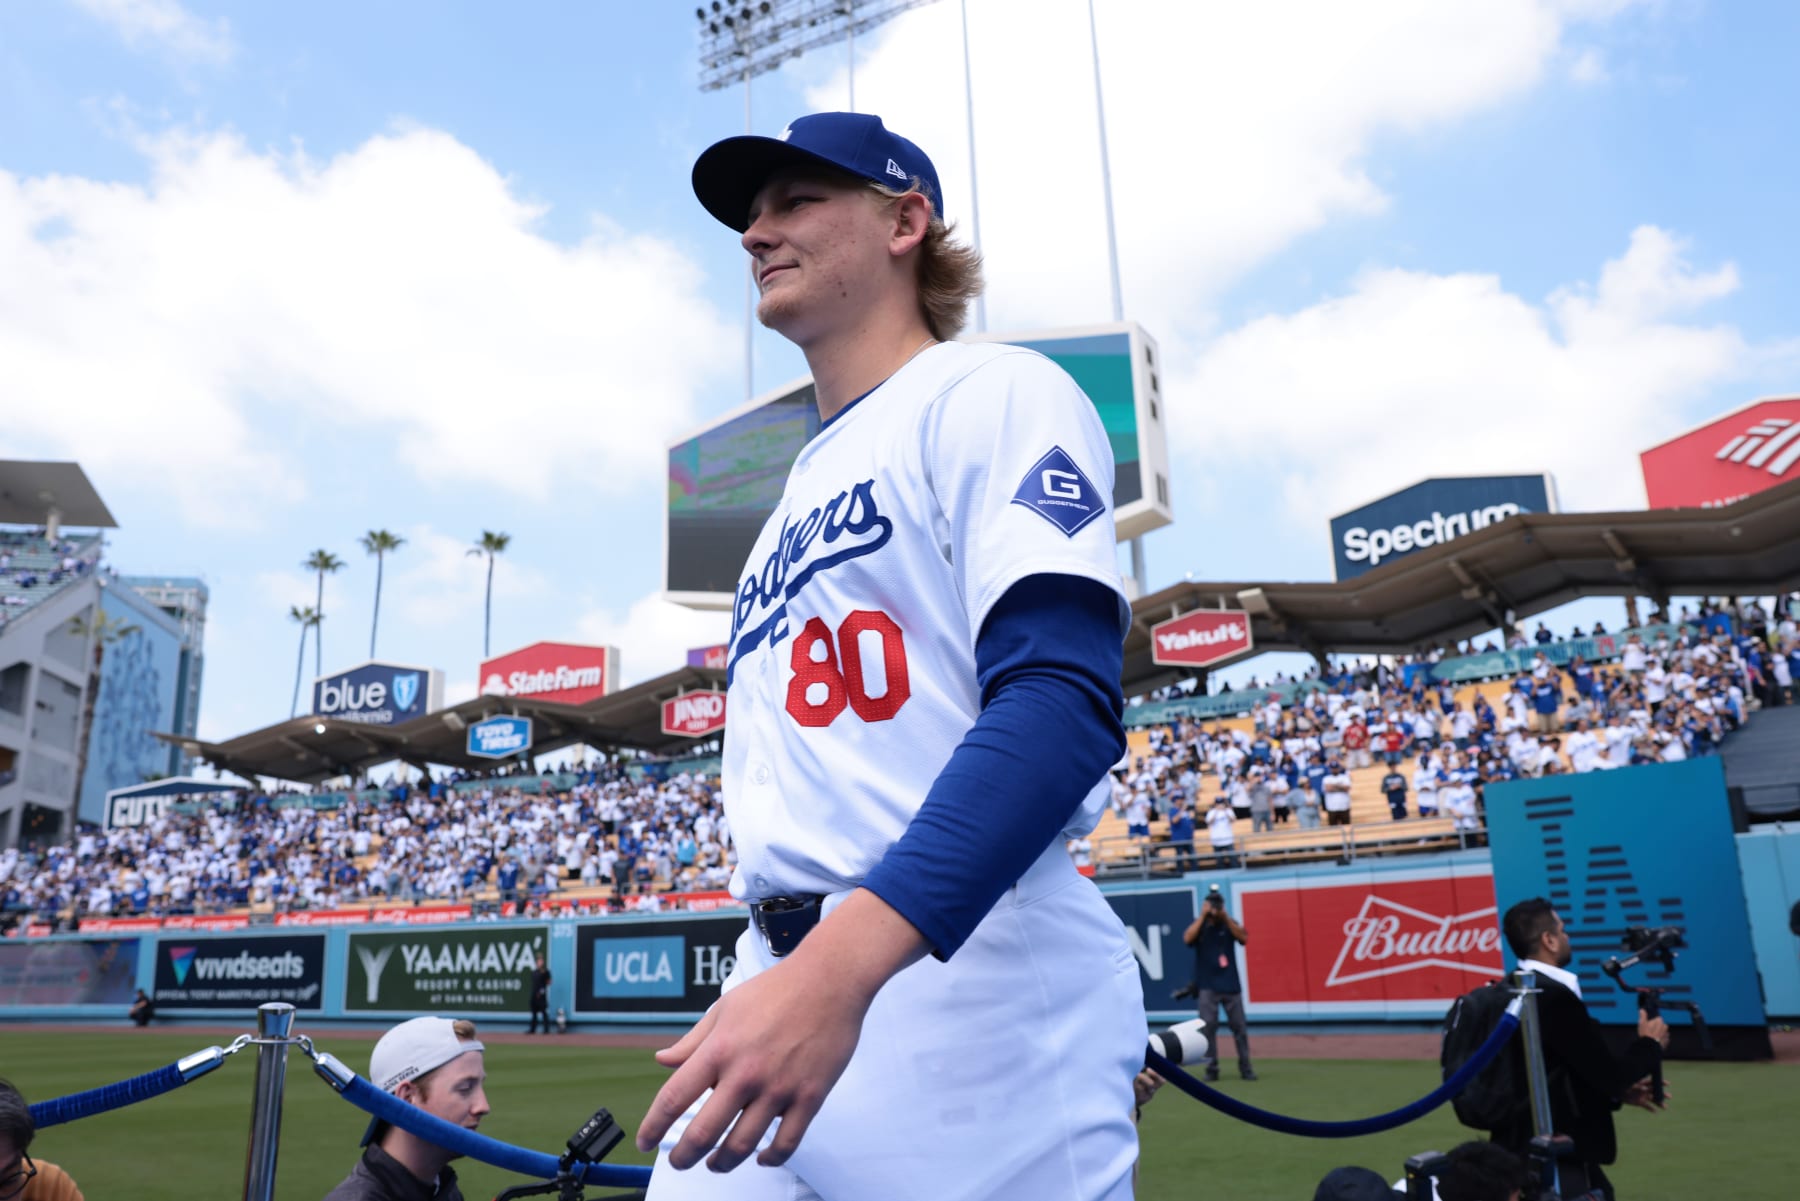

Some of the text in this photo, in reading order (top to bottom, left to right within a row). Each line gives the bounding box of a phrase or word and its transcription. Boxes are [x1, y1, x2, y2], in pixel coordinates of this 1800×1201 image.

[1042, 469, 1081, 500] G
[1343, 502, 1520, 566] Spectrum
[728, 478, 892, 662] odgers
[1157, 622, 1245, 652] Yakult
[786, 610, 911, 727] 80
[320, 678, 387, 713] blue
[672, 695, 723, 729] JINRO
[476, 722, 514, 739] TOYO
[481, 734, 523, 751] TIRES
[605, 950, 673, 984] UCLA
[693, 945, 736, 986] He
[1127, 924, 1164, 981] N
[414, 978, 459, 991] RESORT
[476, 978, 522, 991] CASINO
